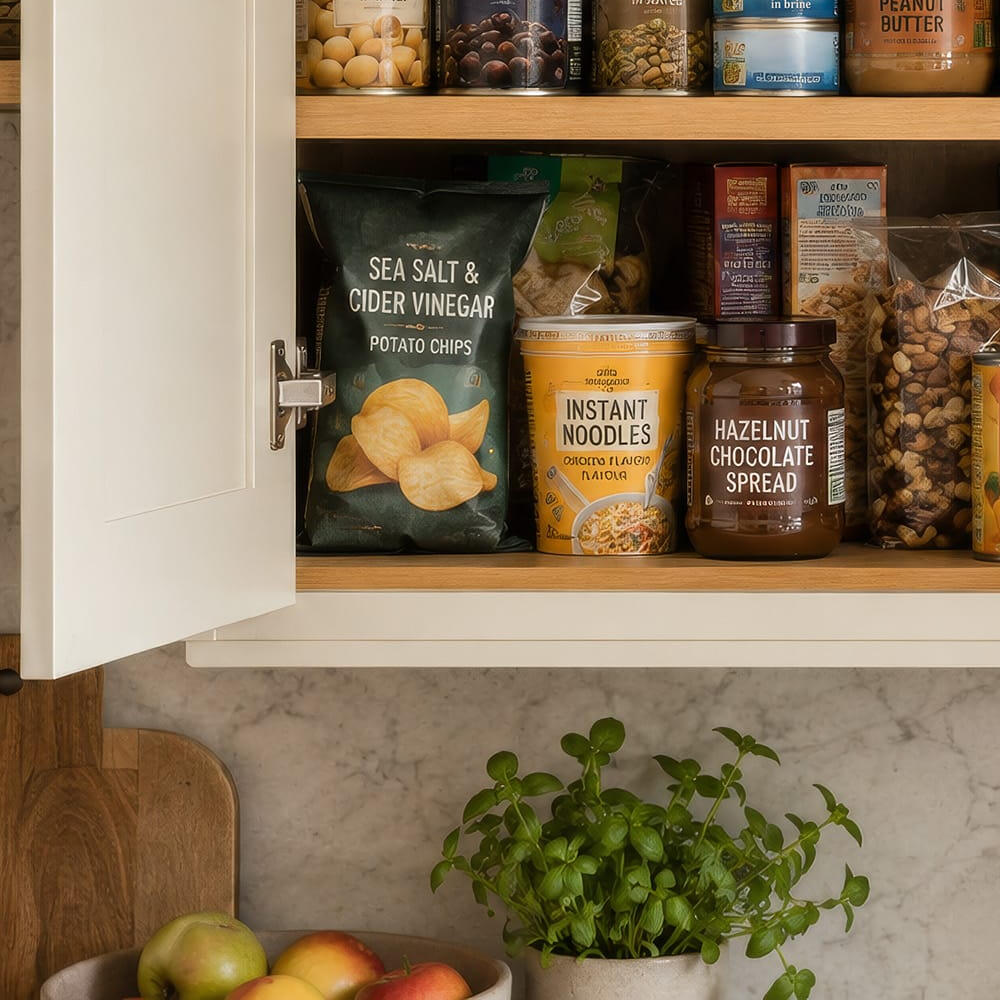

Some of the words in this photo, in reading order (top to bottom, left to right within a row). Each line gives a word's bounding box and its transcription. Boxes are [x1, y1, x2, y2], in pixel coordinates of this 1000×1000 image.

[771, 0, 781, 9] in
[784, 0, 811, 9] brine
[881, 15, 944, 33] BUTTER
[369, 256, 406, 282] SEA
[412, 258, 459, 284] SALT
[464, 261, 479, 284] &
[349, 287, 406, 315] CIDER
[412, 291, 495, 319] VINEGAR
[369, 335, 425, 354] POTATO
[430, 338, 473, 356] CHIPS
[566, 399, 648, 420] INSTANT
[563, 423, 651, 446] NOODLES
[715, 419, 810, 441] HAZELNUT
[710, 445, 814, 467] CHOCOLATE
[726, 471, 797, 493] SPREAD
